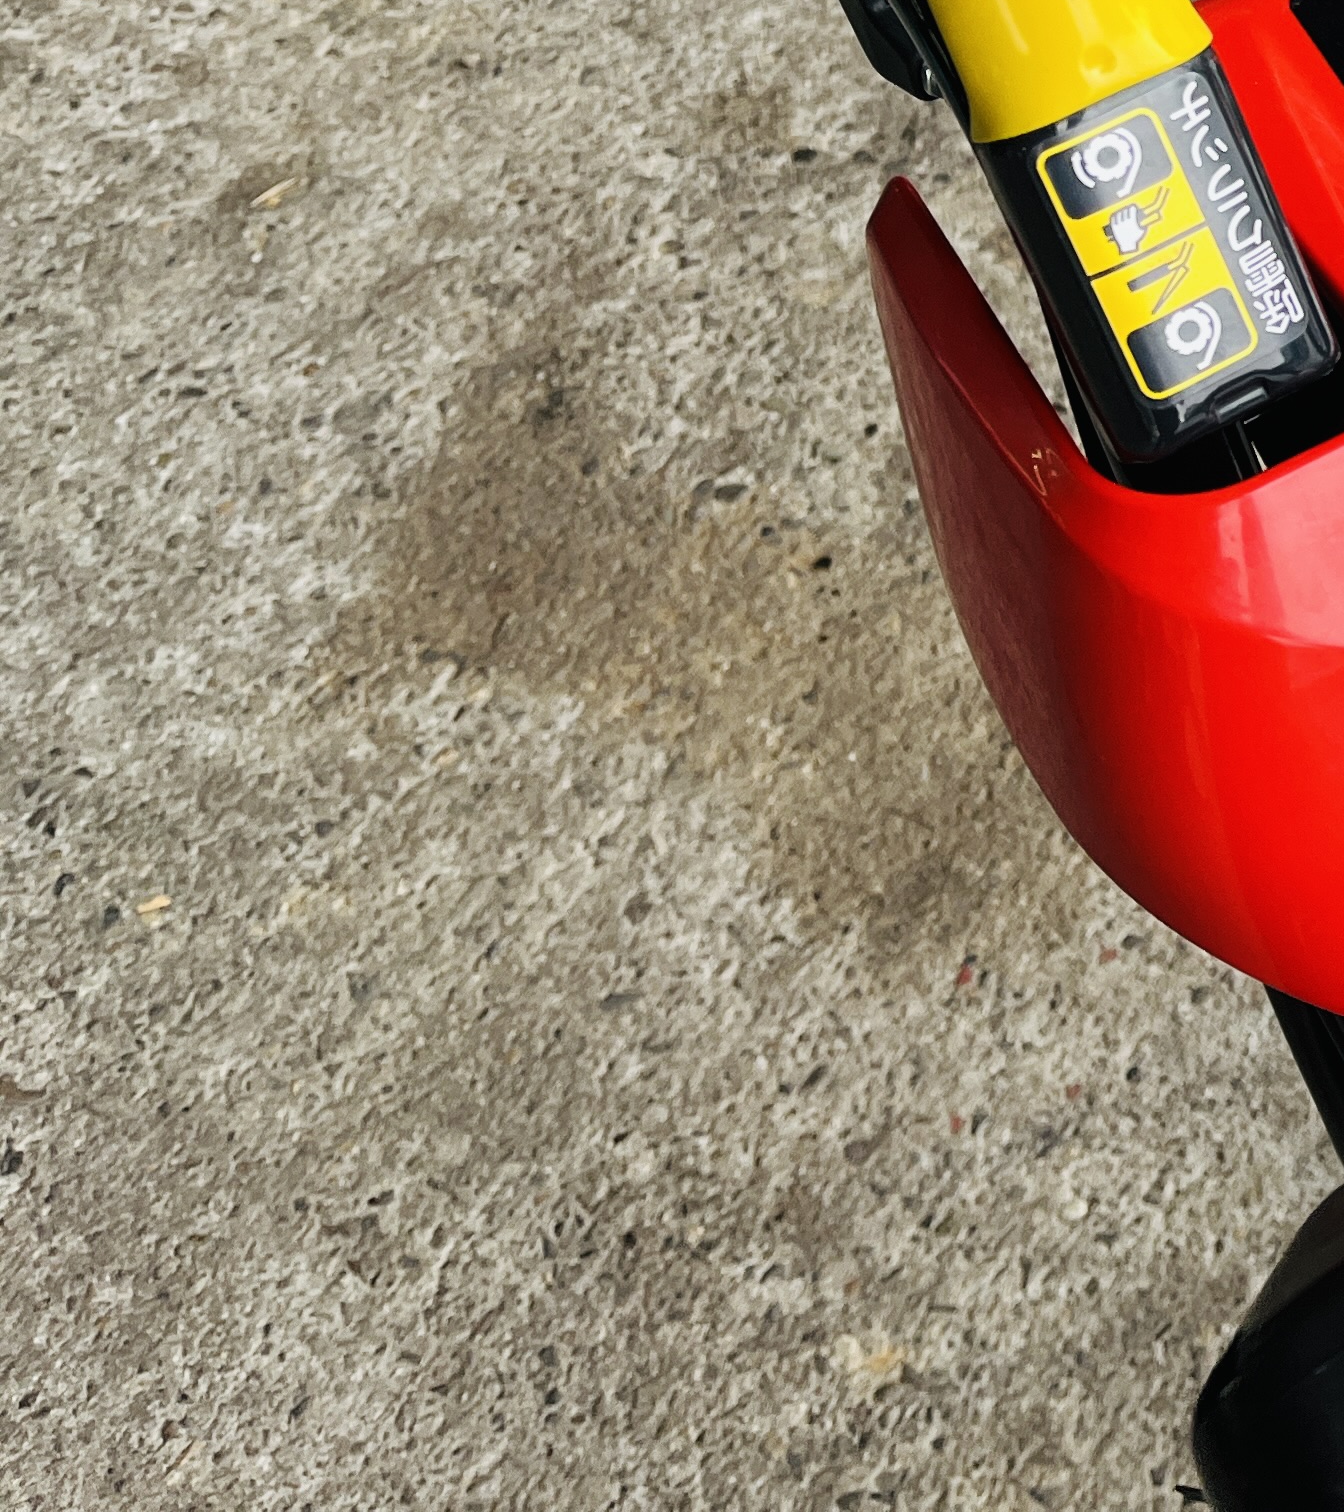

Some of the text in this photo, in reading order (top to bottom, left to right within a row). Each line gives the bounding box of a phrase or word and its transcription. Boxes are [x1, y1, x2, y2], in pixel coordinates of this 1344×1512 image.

[1160, 73, 1304, 333] 除雪クラッチ
